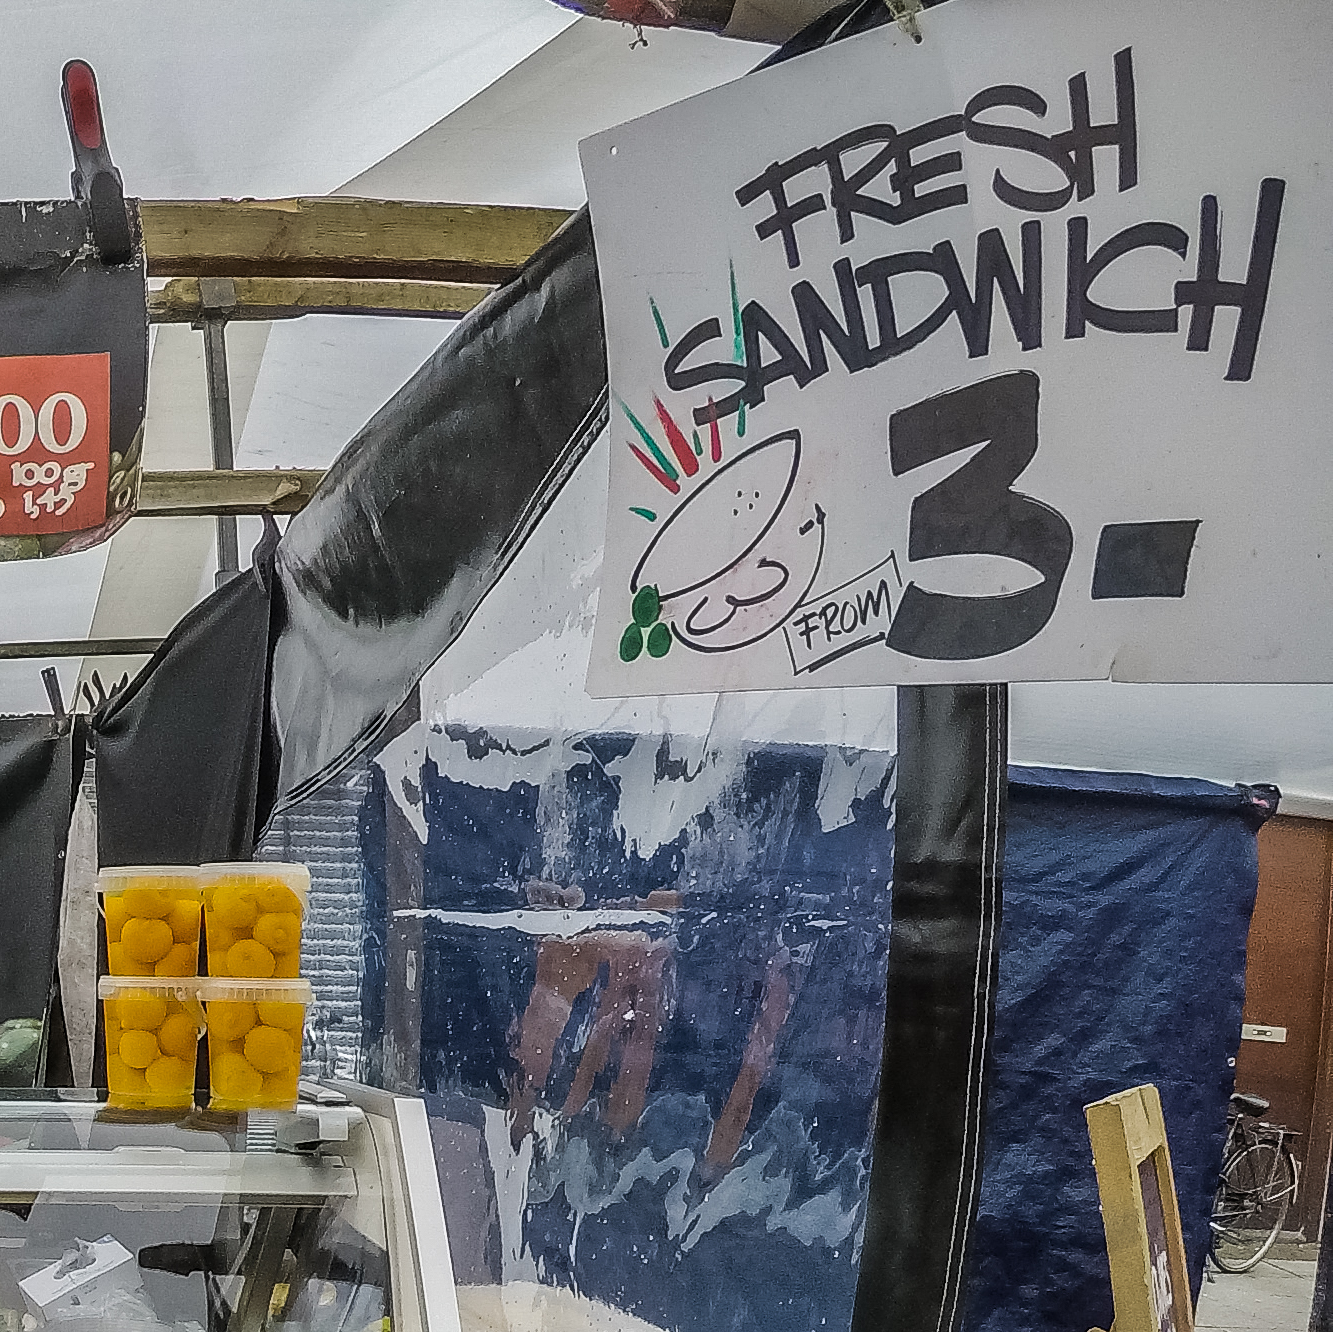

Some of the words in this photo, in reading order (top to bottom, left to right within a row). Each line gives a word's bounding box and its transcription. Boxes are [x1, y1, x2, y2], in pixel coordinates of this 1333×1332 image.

[736, 46, 1137, 269] FRESH
[665, 178, 1285, 424] SANDWICH
[792, 579, 893, 650] FROM
